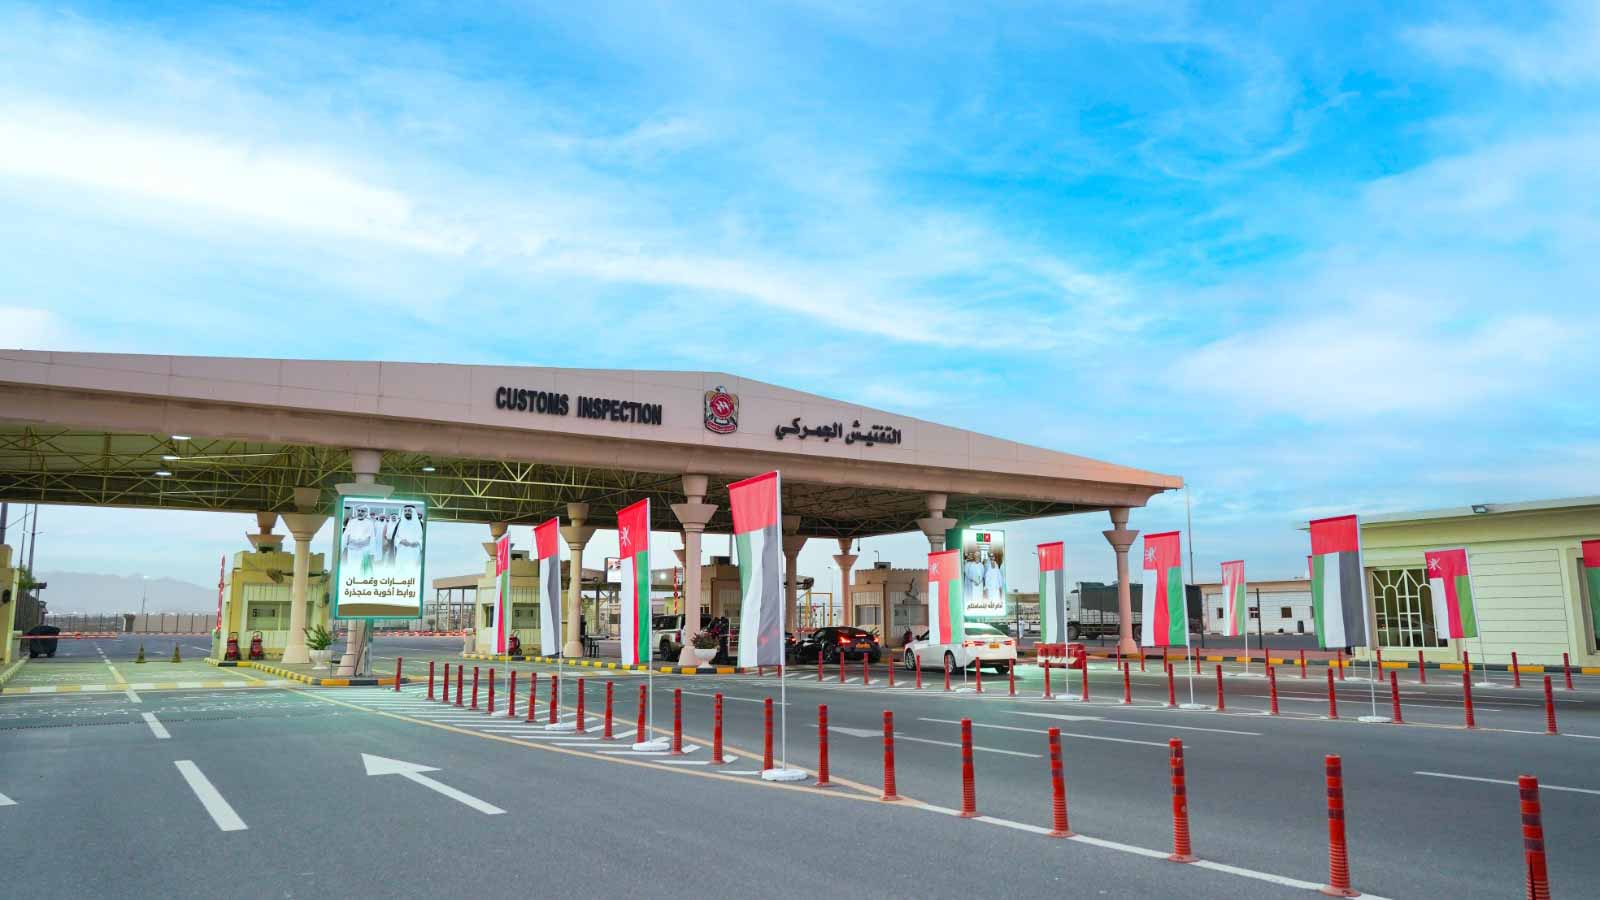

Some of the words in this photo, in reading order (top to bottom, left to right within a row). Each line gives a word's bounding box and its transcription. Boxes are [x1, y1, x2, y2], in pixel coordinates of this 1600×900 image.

[496, 386, 569, 416] CUSTOMS
[578, 396, 662, 425] INSPECTION
[775, 417, 843, 442] الجمركي
[845, 420, 902, 446] التفتيش
[379, 577, 415, 588] الإمارات
[344, 588, 372, 598] متجذرة
[373, 587, 395, 598] أخوية
[396, 588, 416, 598] روابط
